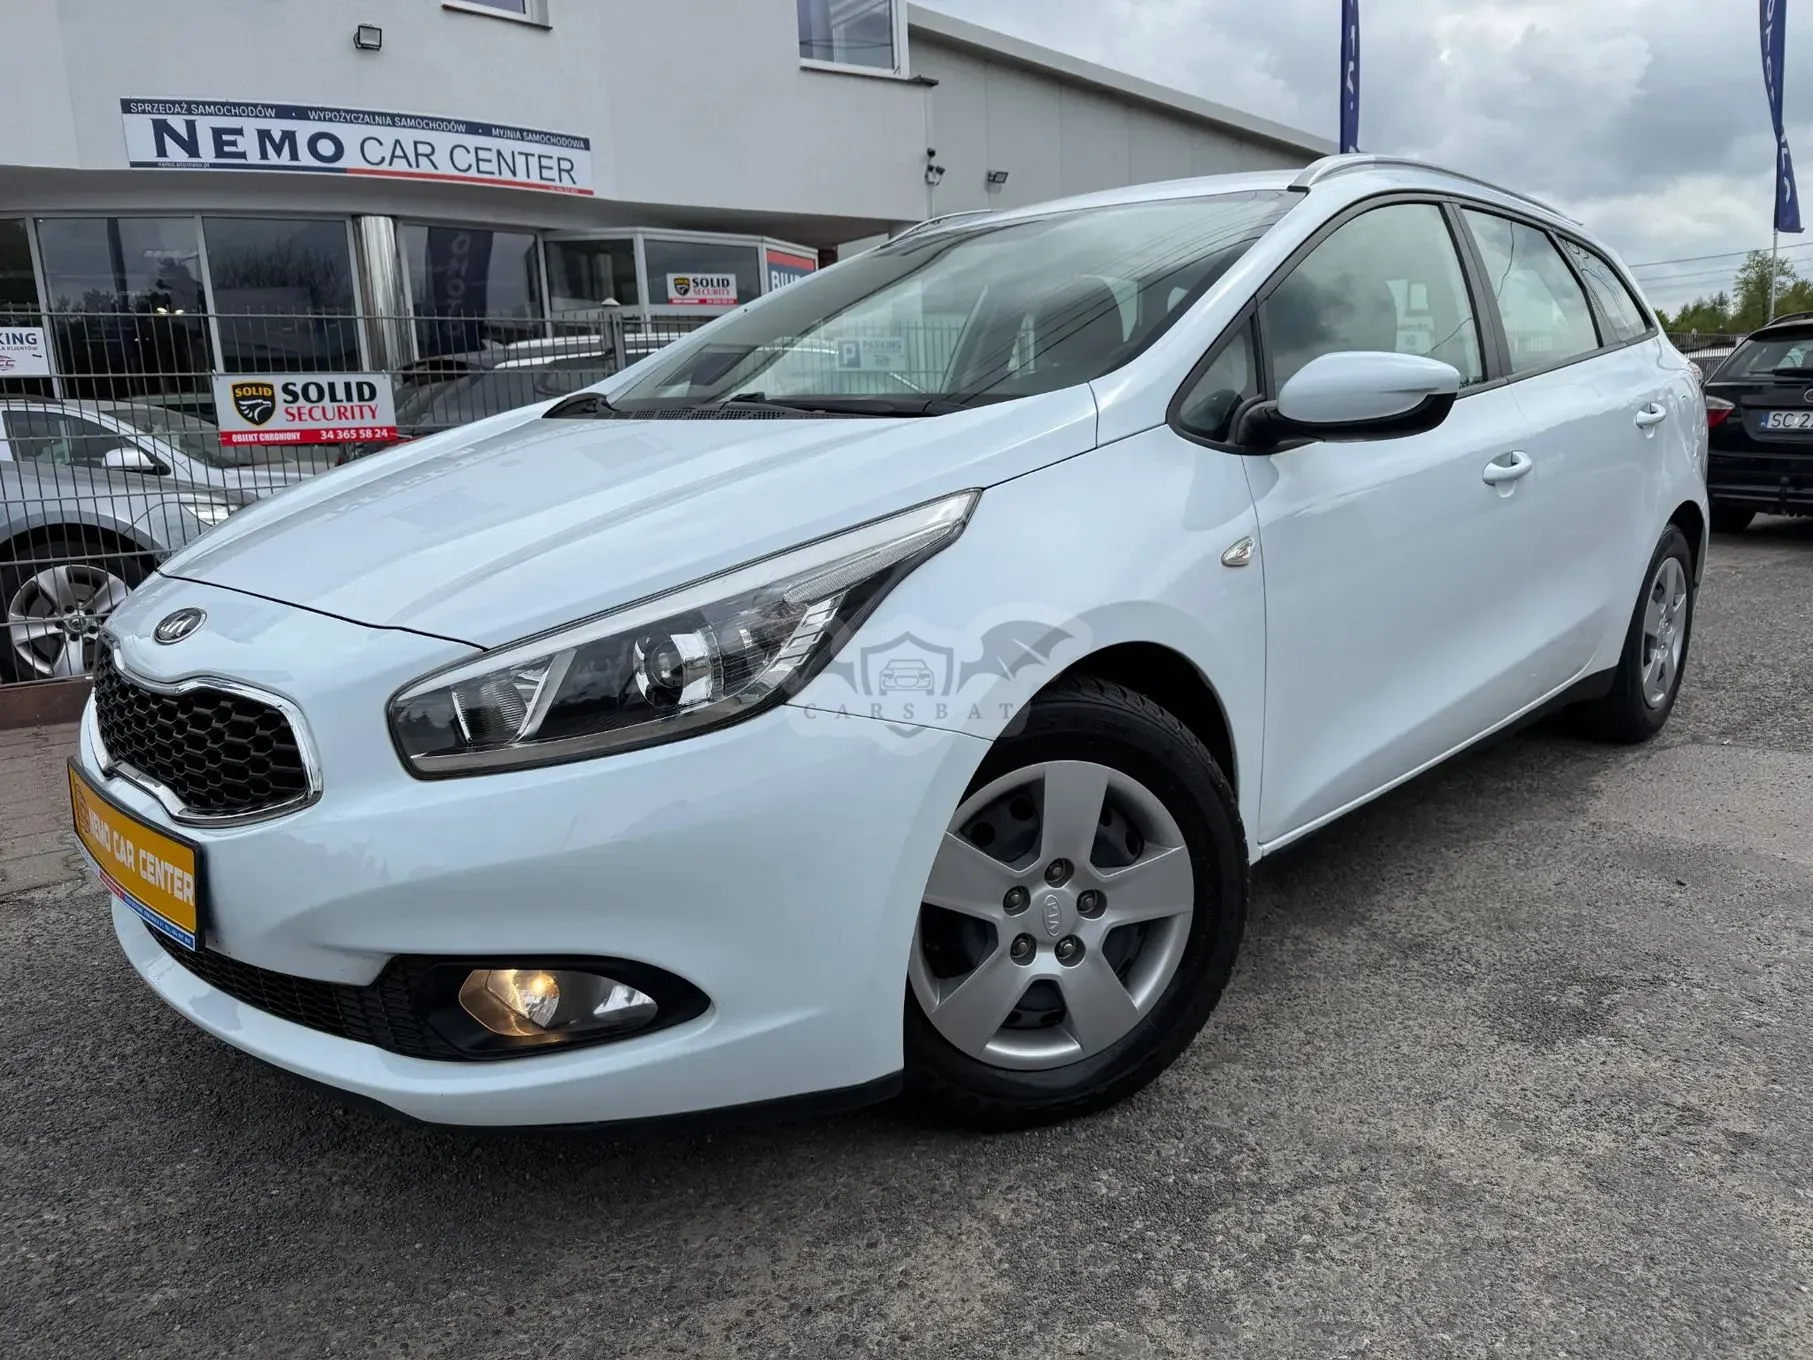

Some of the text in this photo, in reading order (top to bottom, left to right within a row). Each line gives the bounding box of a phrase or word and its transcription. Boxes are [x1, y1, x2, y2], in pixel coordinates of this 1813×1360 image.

[130, 102, 585, 149] SPRZEDAŻ SAMOCHODÓW WYPOŻYCZALNIA SAMOCHODÓW MYJNIA SAMOCHODOWA
[149, 117, 577, 185] NEMO CAR CENTER
[692, 277, 730, 288] SOLID
[693, 288, 730, 296] SECURITY
[235, 387, 273, 398] SOLID
[281, 381, 377, 404] SOLID
[284, 404, 379, 422] SECURITY
[1771, 413, 1813, 427] SC 2
[259, 431, 301, 442] CHRONIONY
[320, 430, 334, 440] 34
[336, 429, 356, 439] 365
[359, 429, 372, 439] 58
[374, 428, 388, 438] 24
[113, 830, 136, 872] CAR
[139, 848, 195, 906] CENTER
